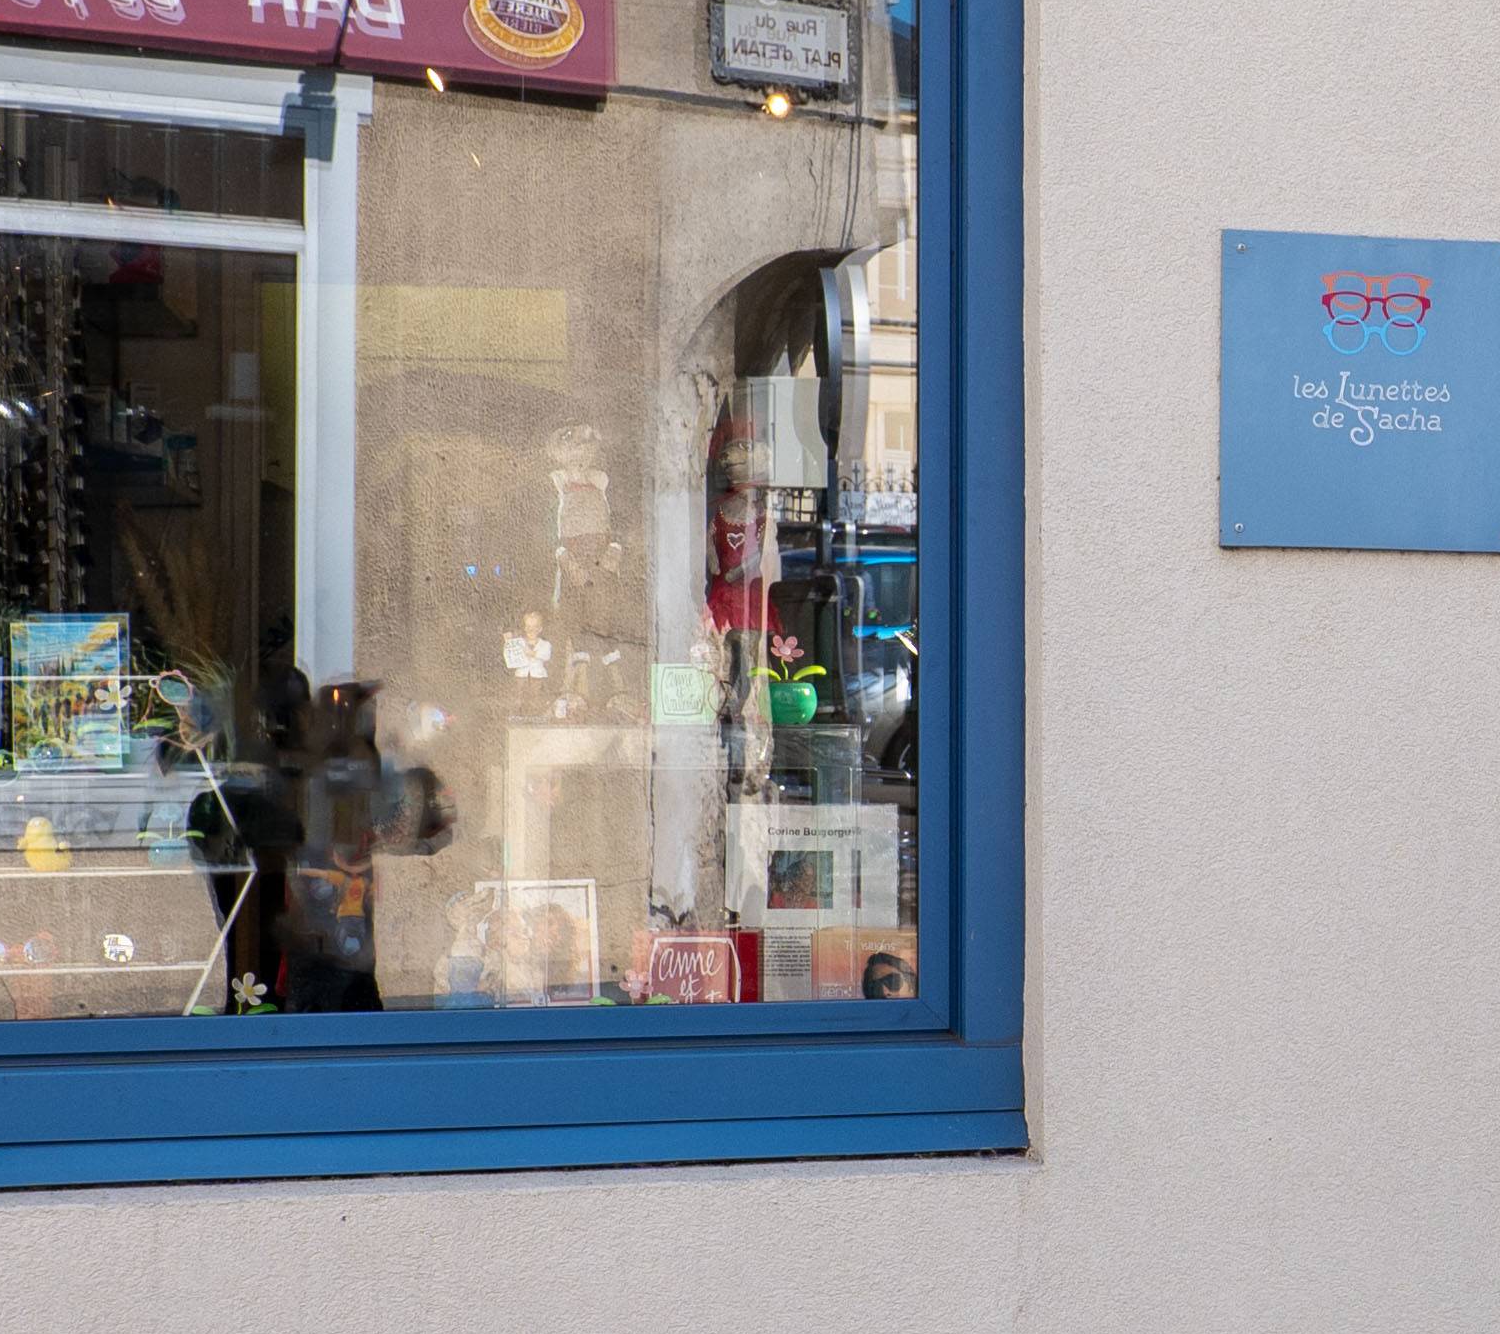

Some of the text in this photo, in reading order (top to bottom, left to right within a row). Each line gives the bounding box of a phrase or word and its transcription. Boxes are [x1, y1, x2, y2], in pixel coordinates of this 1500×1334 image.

[1293, 371, 1451, 411] les Lunettes
[1312, 404, 1442, 446] de Sacha
